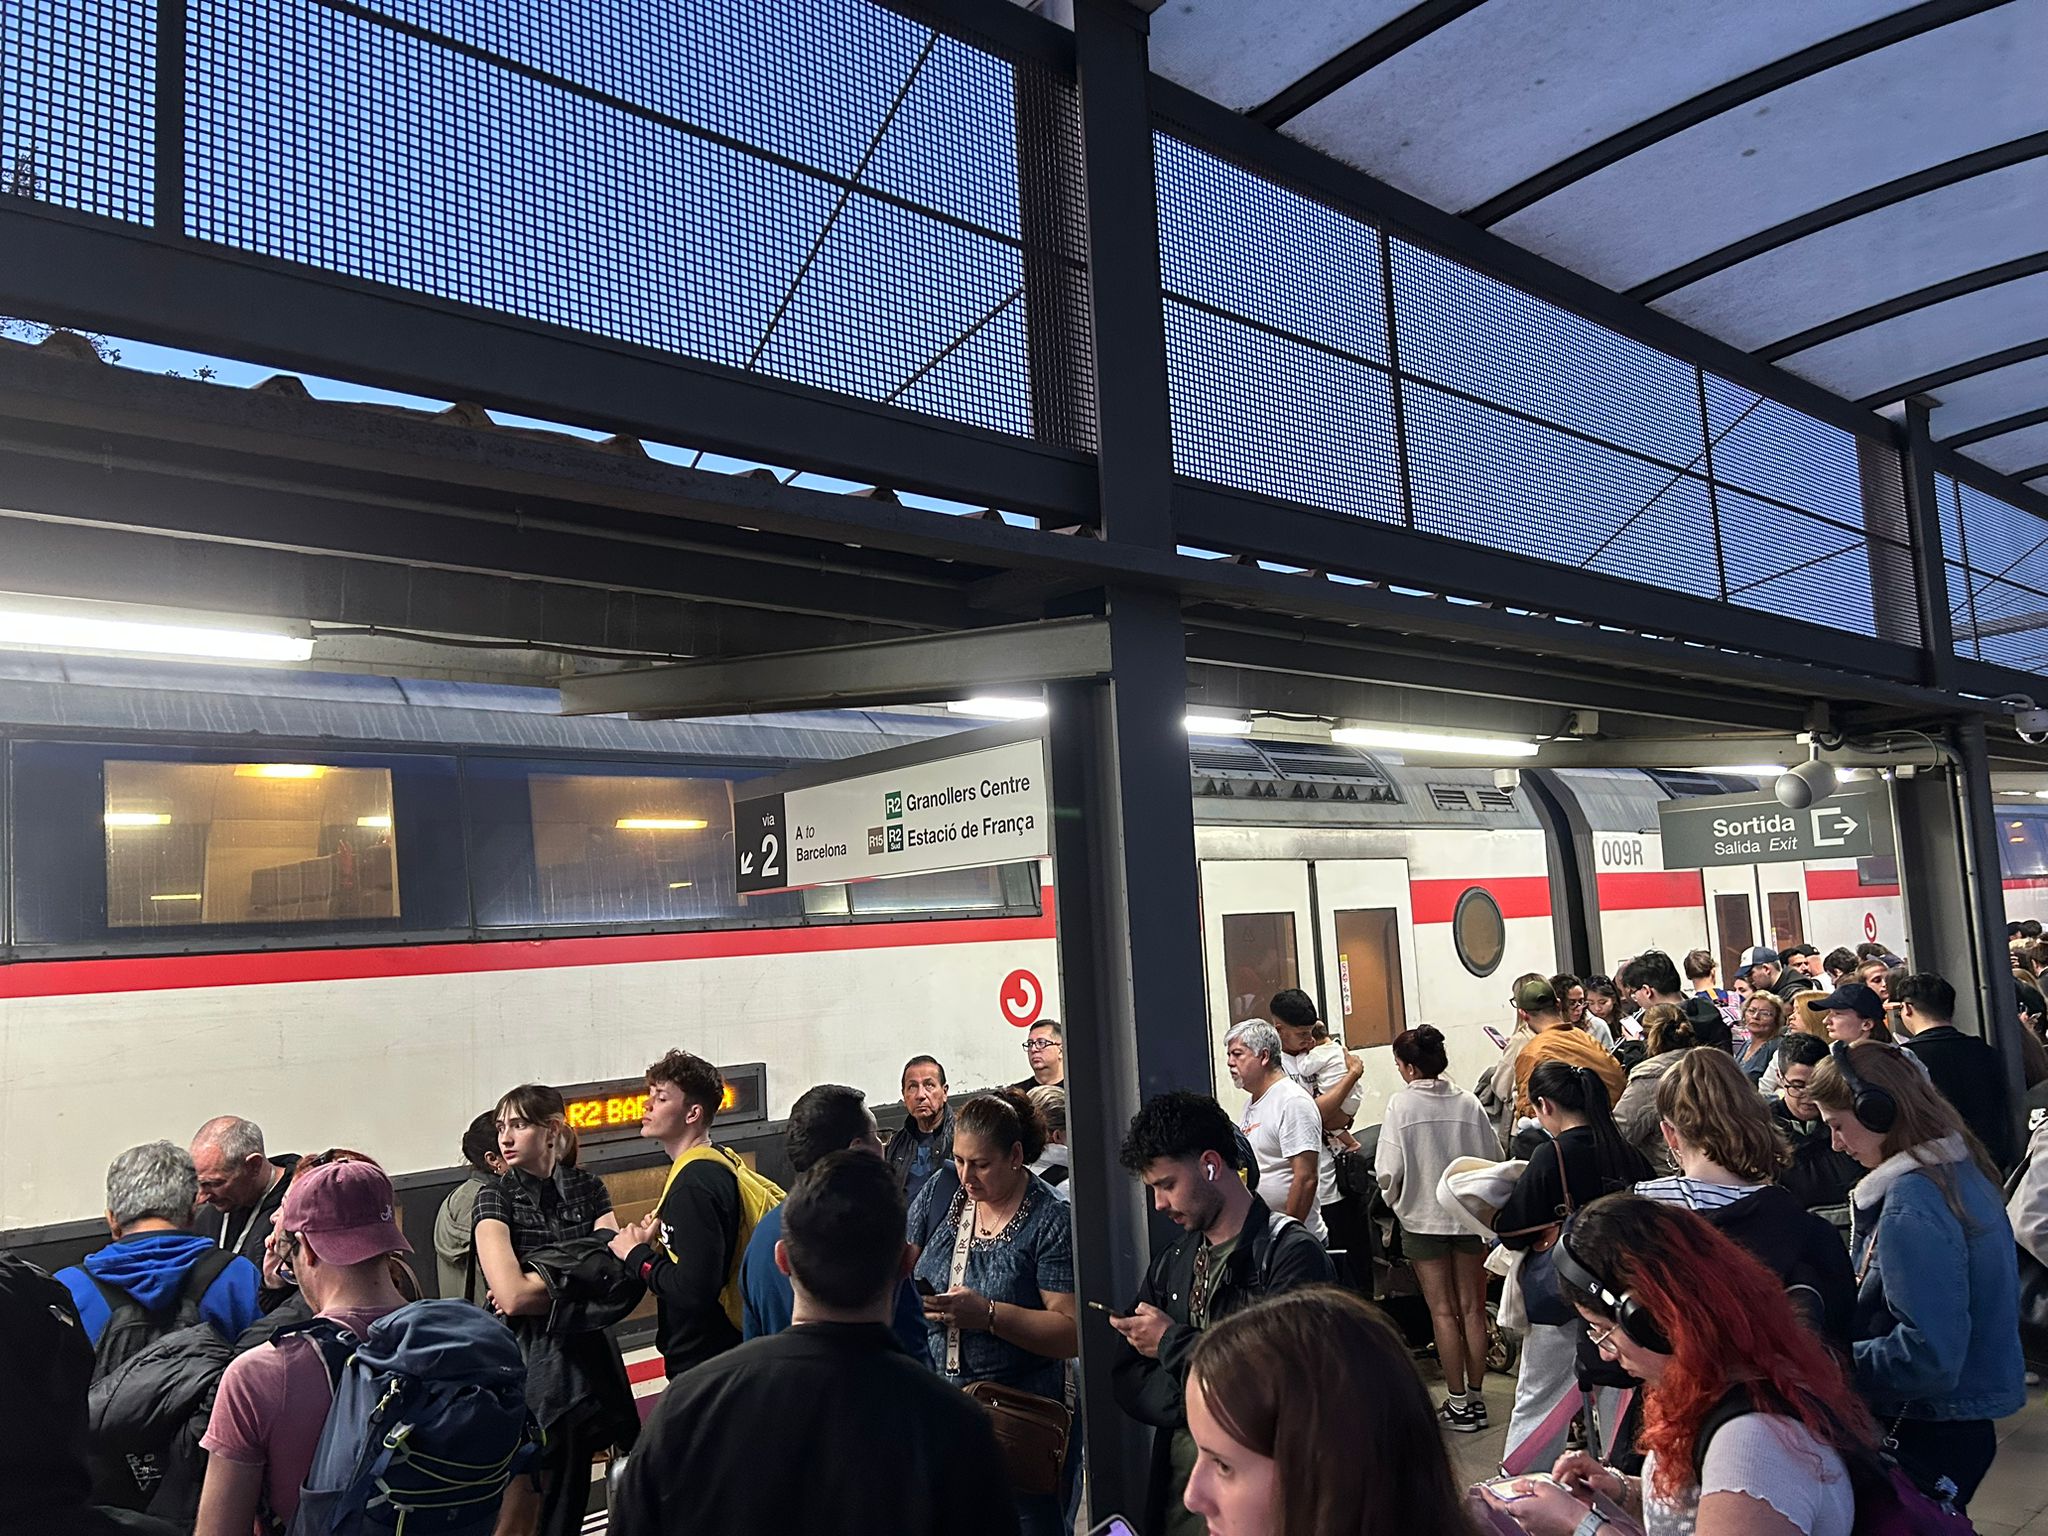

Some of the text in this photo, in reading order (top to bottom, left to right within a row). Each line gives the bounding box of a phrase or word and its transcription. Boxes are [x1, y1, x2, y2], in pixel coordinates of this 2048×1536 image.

[886, 776, 1030, 814] R2 Granollers Centre
[762, 812, 775, 826] via
[1713, 814, 1795, 837] Sortida
[795, 825, 815, 840] A to
[869, 815, 1034, 848] R15 R2 Estació de França
[761, 833, 779, 877] 2
[796, 843, 847, 862] Barcelona
[1601, 839, 1643, 866] 009R
[1714, 837, 1798, 855] Salida Exit
[568, 1101, 602, 1127] R2
